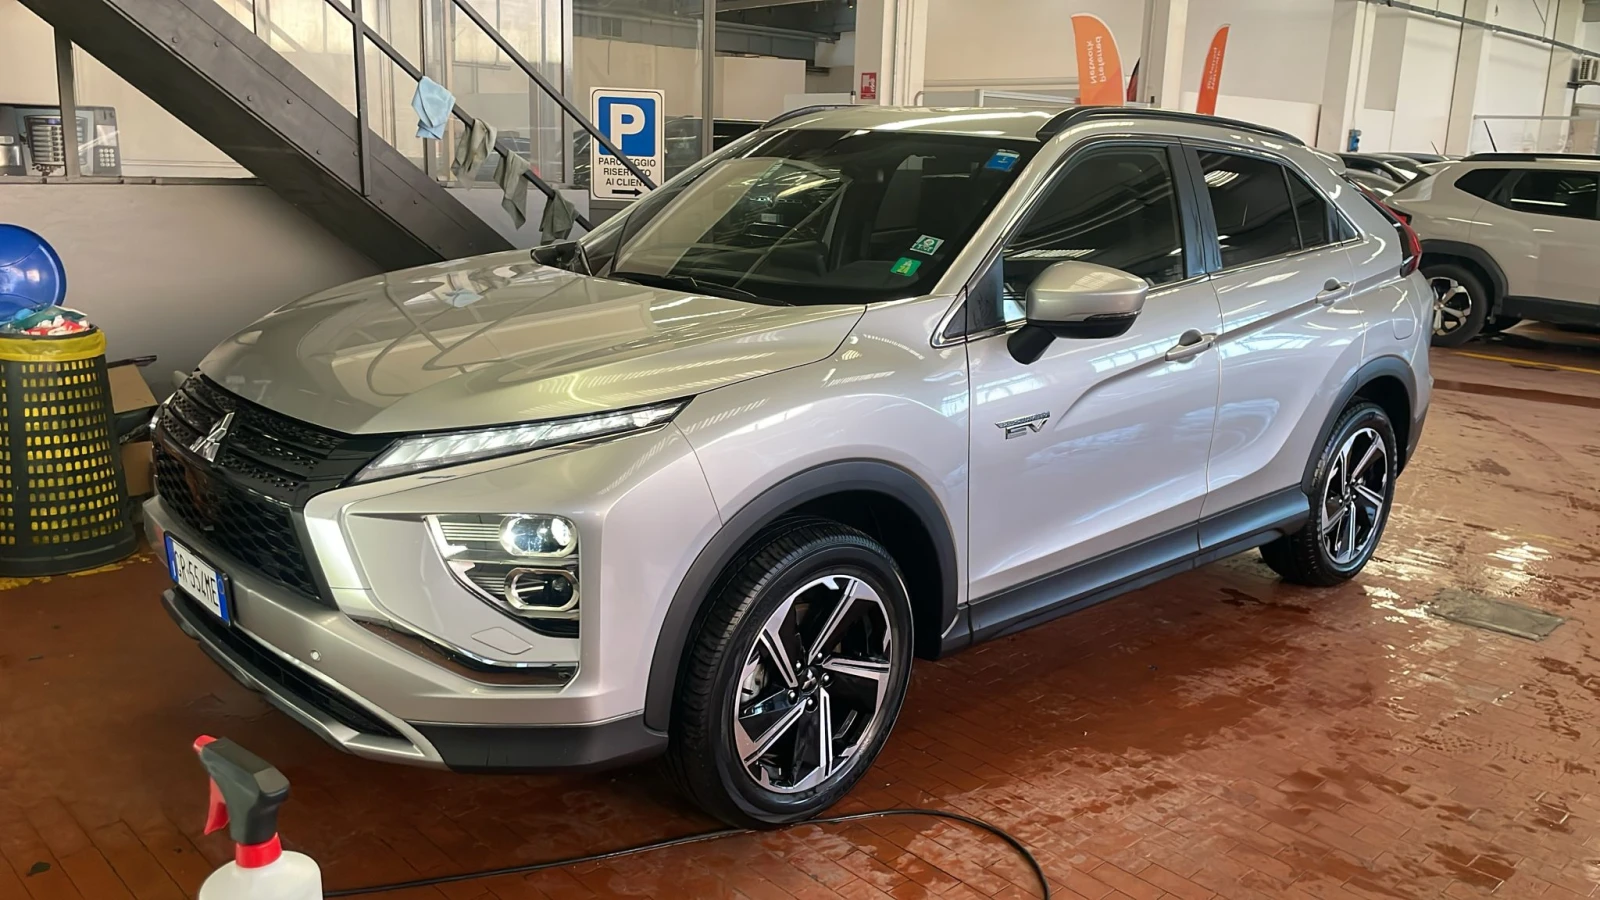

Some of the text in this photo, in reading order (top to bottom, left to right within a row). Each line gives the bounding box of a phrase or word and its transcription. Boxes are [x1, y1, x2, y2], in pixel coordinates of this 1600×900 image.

[610, 103, 646, 151] P
[598, 157, 656, 168] PARCGGIO
[606, 178, 614, 186] AI
